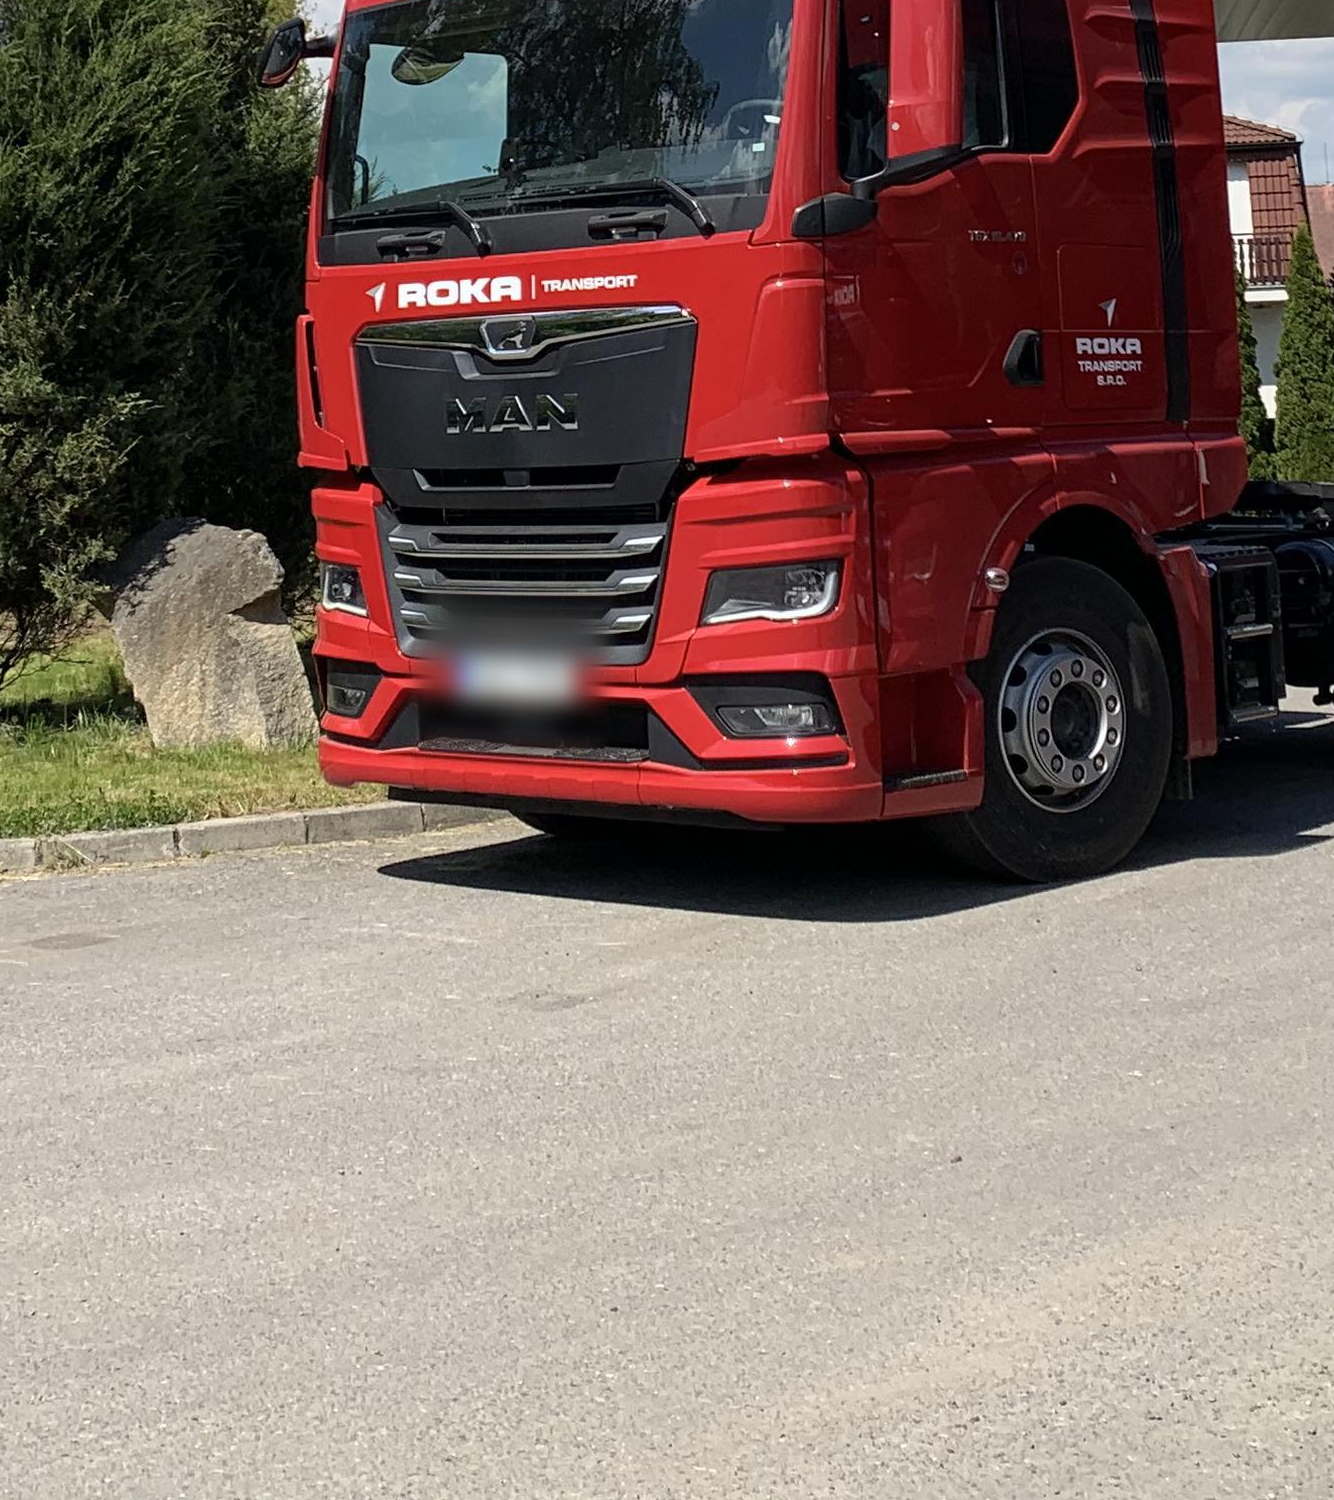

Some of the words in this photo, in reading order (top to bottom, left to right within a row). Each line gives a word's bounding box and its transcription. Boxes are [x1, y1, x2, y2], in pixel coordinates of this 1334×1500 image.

[397, 276, 522, 309] ROKA
[540, 274, 638, 293] TRANSPORT
[1075, 337, 1142, 355] ROKA
[1077, 360, 1143, 373] TRANSPORT
[446, 393, 579, 434] MAN
